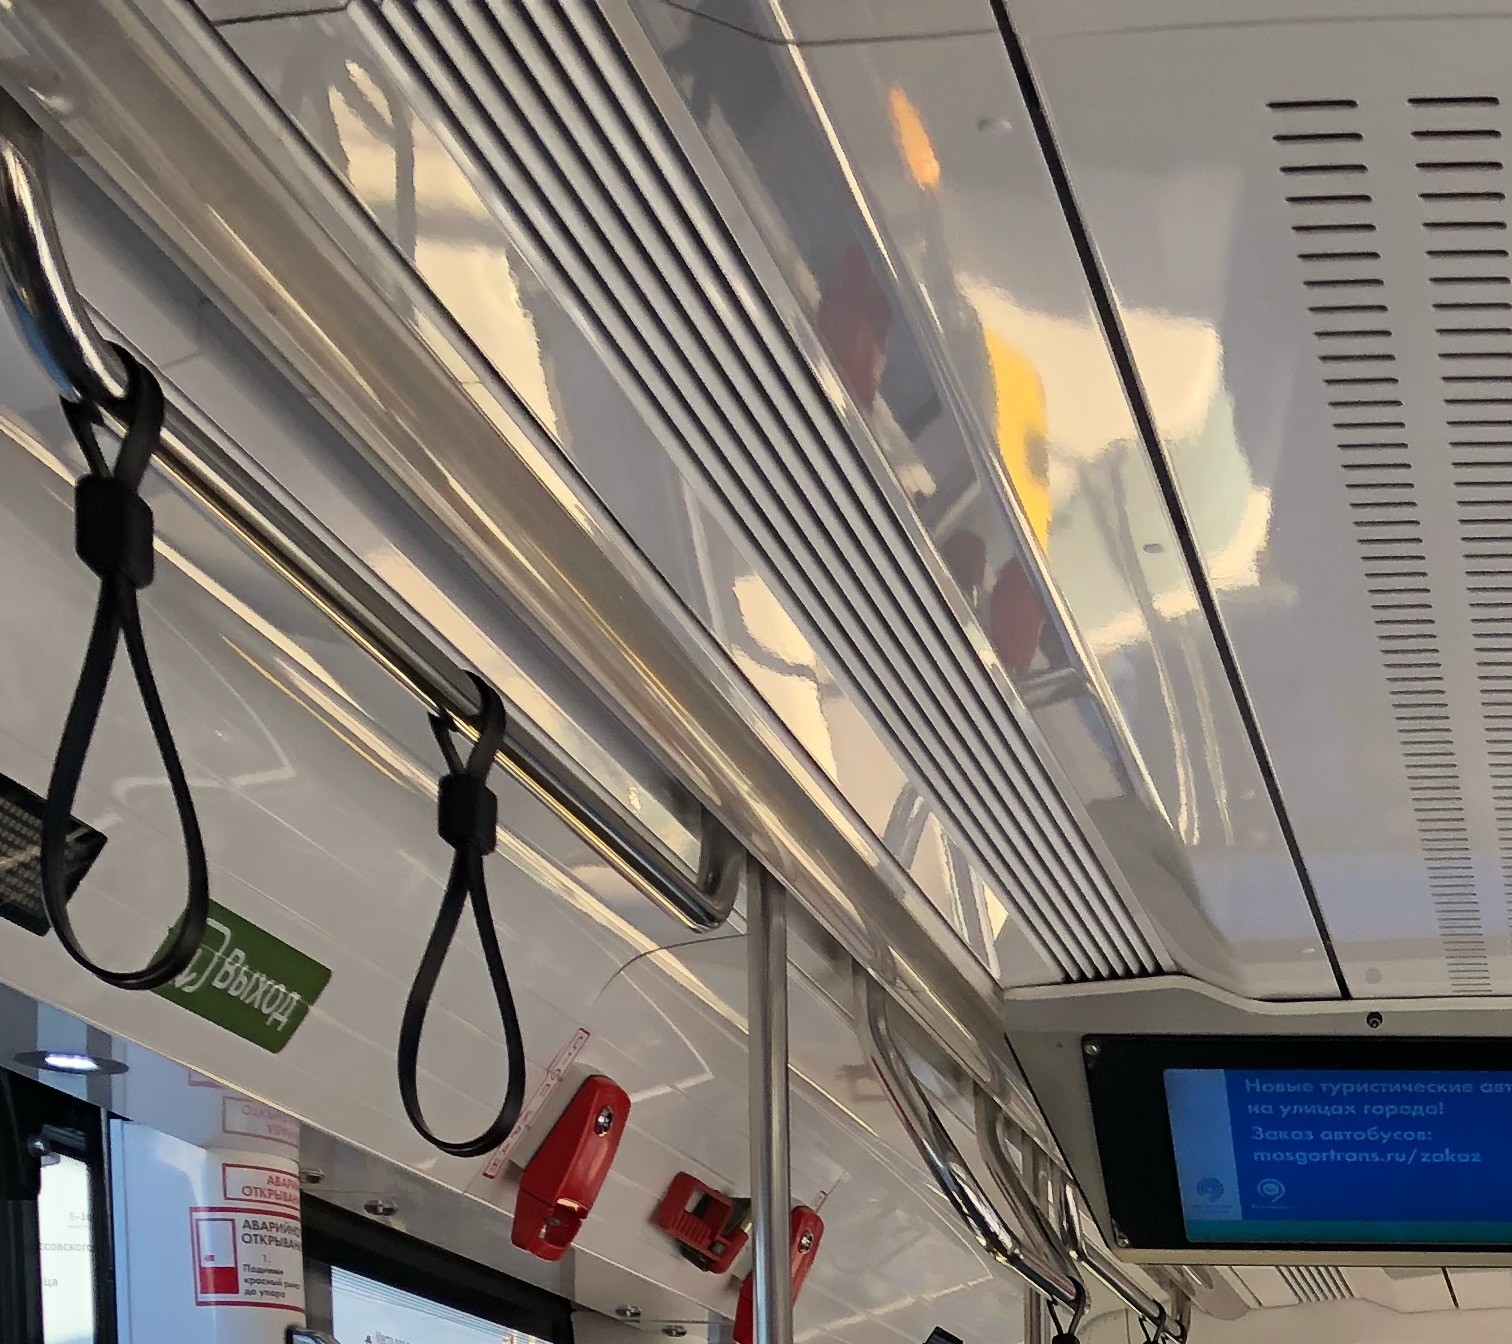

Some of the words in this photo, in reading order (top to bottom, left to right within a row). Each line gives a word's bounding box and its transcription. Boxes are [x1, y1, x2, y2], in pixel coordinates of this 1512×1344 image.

[212, 949, 301, 1031] Выход
[1245, 1078, 1314, 1095] Новые
[1320, 1078, 1474, 1098] туристические
[1247, 1102, 1276, 1115] на
[1280, 1102, 1358, 1119] улицах
[1363, 1101, 1445, 1118] города!
[1250, 1126, 1315, 1142] Заказ
[1320, 1126, 1433, 1144] автобусов:
